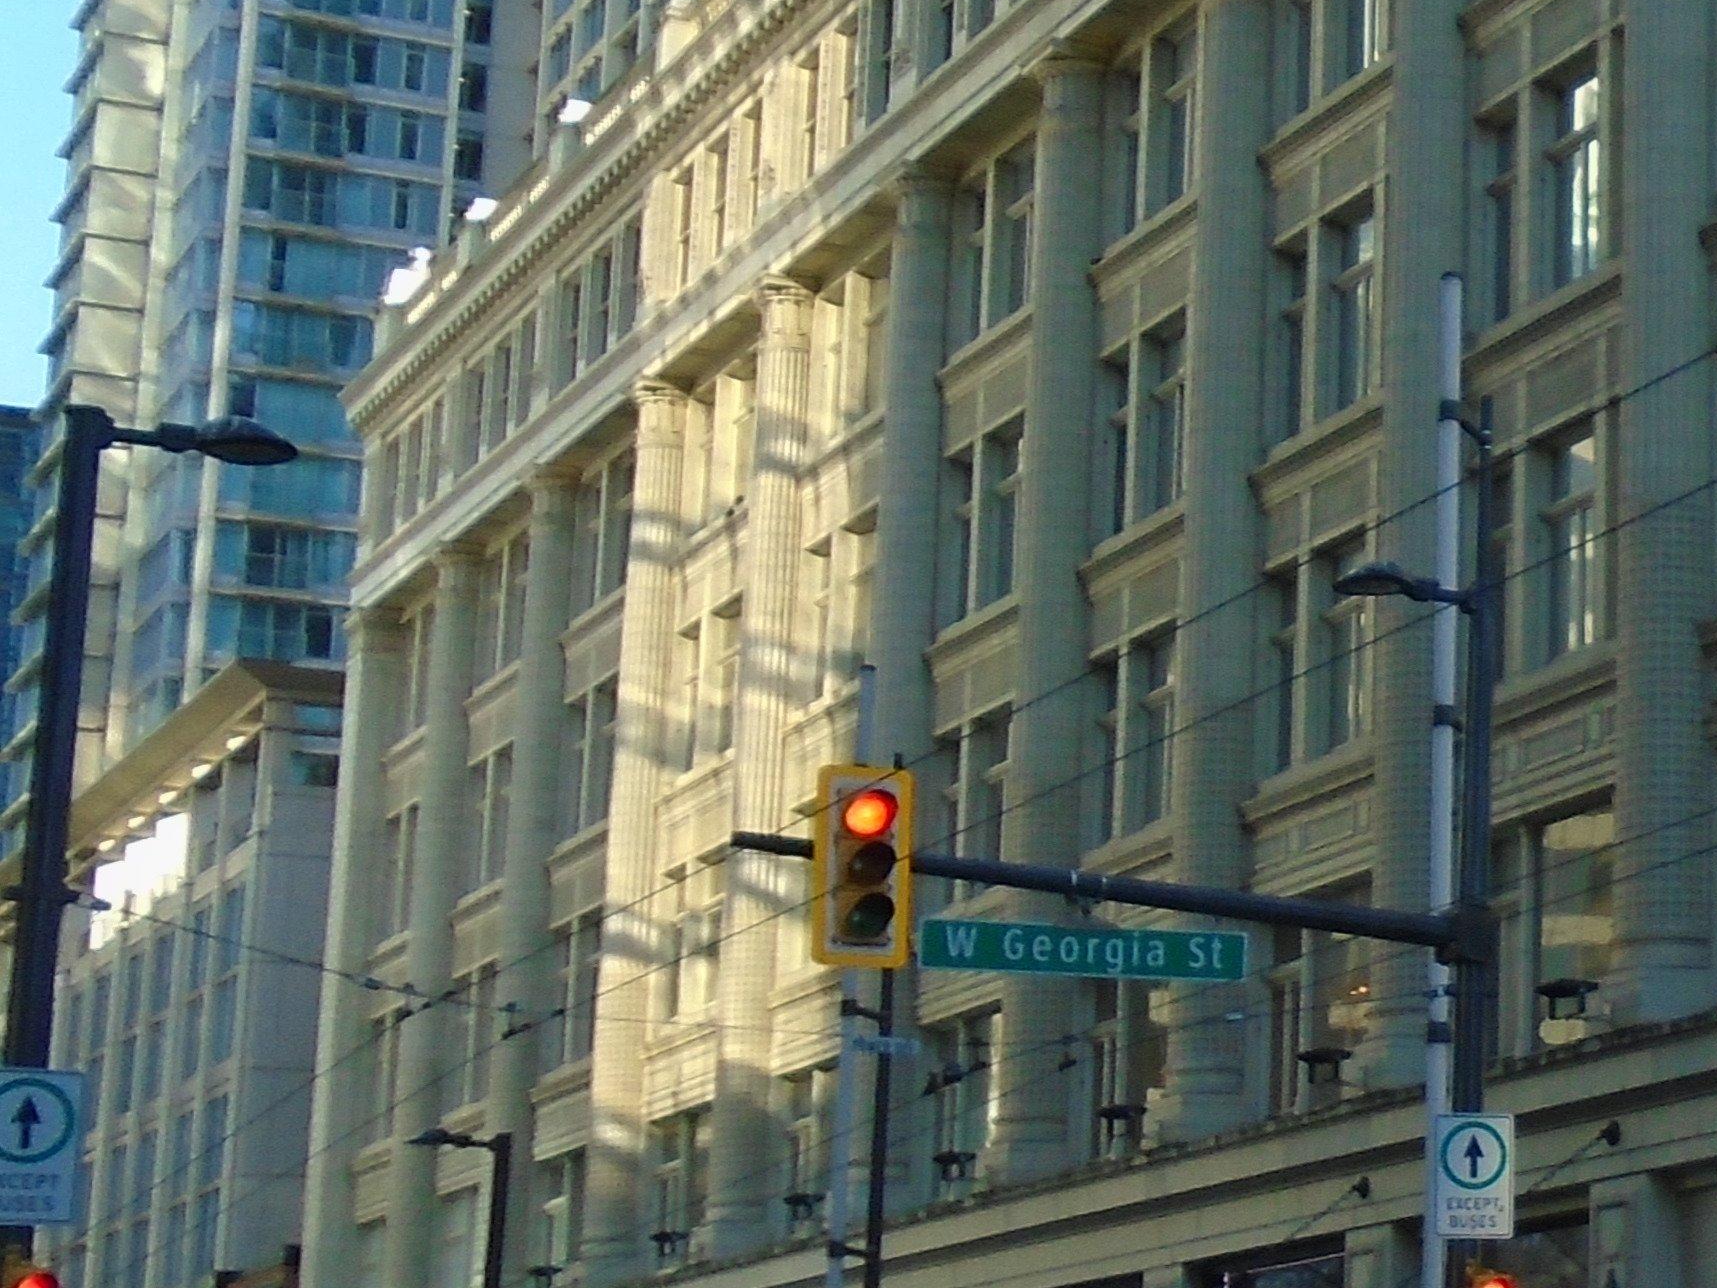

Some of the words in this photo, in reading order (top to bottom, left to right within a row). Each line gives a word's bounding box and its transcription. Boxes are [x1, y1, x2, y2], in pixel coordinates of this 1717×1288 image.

[945, 925, 978, 958] W
[1003, 928, 1165, 974] Georgia
[1188, 936, 1223, 969] St
[1446, 1197, 1500, 1211] EXCEPT
[1449, 1214, 1497, 1229] BUSES
